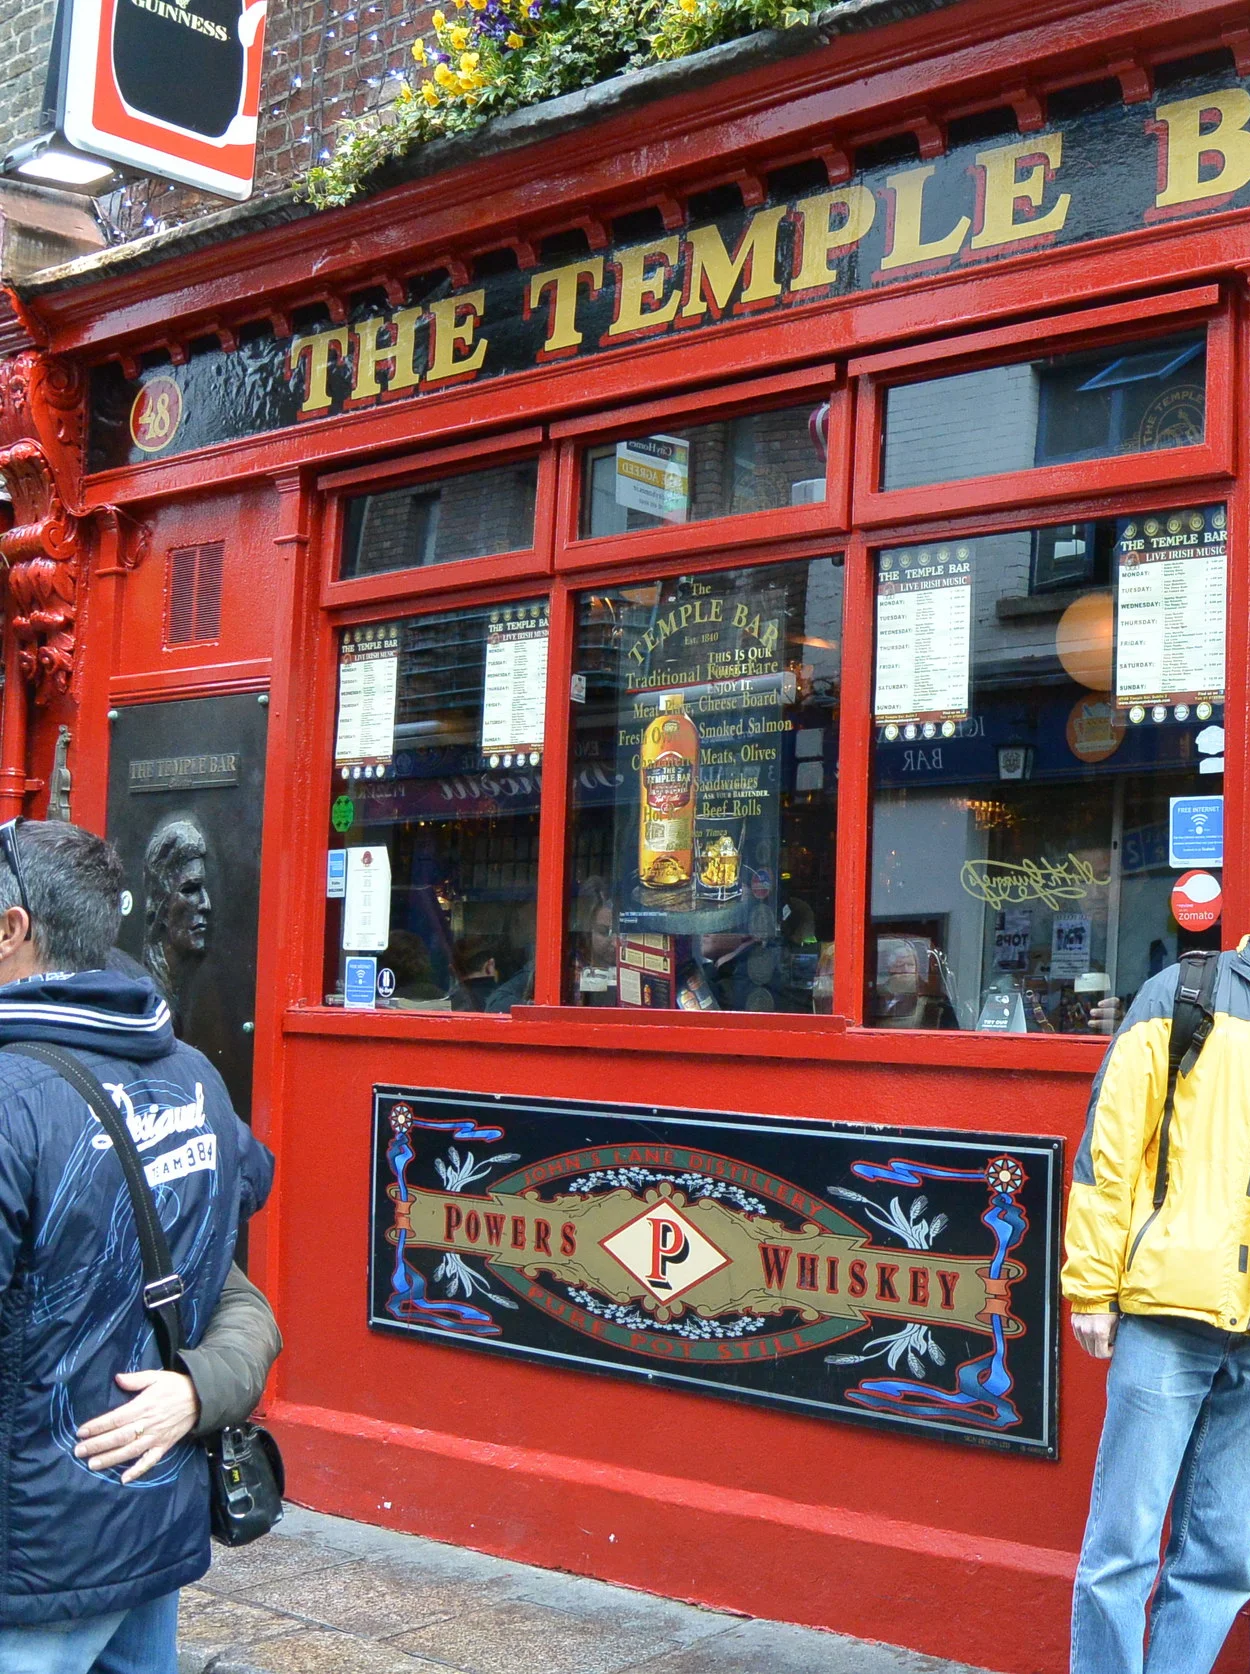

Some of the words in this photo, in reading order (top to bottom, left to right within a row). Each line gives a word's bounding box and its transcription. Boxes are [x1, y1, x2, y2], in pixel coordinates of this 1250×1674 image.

[132, 0, 228, 41] GUINNESS
[292, 290, 488, 412] THE
[530, 132, 1071, 353] TEMPLE
[138, 392, 171, 439] 48
[1121, 539, 1145, 551] THE
[1151, 533, 1198, 549] TEMPLE
[1204, 531, 1228, 543] BAR
[1146, 552, 1167, 562] LIVE
[1169, 549, 1193, 559] IRISH
[1196, 545, 1226, 556] MUSIC
[878, 570, 899, 582] THE
[905, 565, 944, 580] TEMPLE
[948, 562, 970, 574] BAR
[691, 582, 712, 596] The
[900, 582, 919, 592] LIVE
[920, 579, 941, 590] IRISH
[942, 576, 968, 587] MUSIC
[488, 624, 503, 633] THE
[506, 620, 536, 630] TEMPLE
[538, 618, 549, 627] BA
[628, 598, 723, 667] TEMPLE
[732, 603, 779, 651] BAR
[342, 644, 355, 654] THE
[358, 641, 381, 652] TEMPLE
[384, 639, 398, 648] BAR
[735, 649, 745, 661] IS
[625, 665, 700, 689] Traditional
[699, 696, 737, 712] Cheese
[742, 692, 777, 707] Board
[699, 719, 743, 739] Smoked
[748, 717, 792, 734] Salmon
[701, 748, 736, 766] Meats,
[741, 744, 777, 760] Olives
[130, 763, 153, 779] THE
[157, 757, 206, 777] TEMPLE
[210, 755, 236, 773] BAR
[702, 800, 729, 817] Beef
[733, 798, 762, 817] Rolls
[1178, 911, 1214, 921] zomato
[613, 1147, 676, 1166] LANE
[687, 1152, 824, 1220] DISTILLERY
[443, 1202, 577, 1257] POWERS
[646, 1216, 690, 1291] P
[757, 1242, 961, 1309] WHISKEY
[629, 1334, 699, 1359] POT
[715, 1331, 819, 1362] STILL
